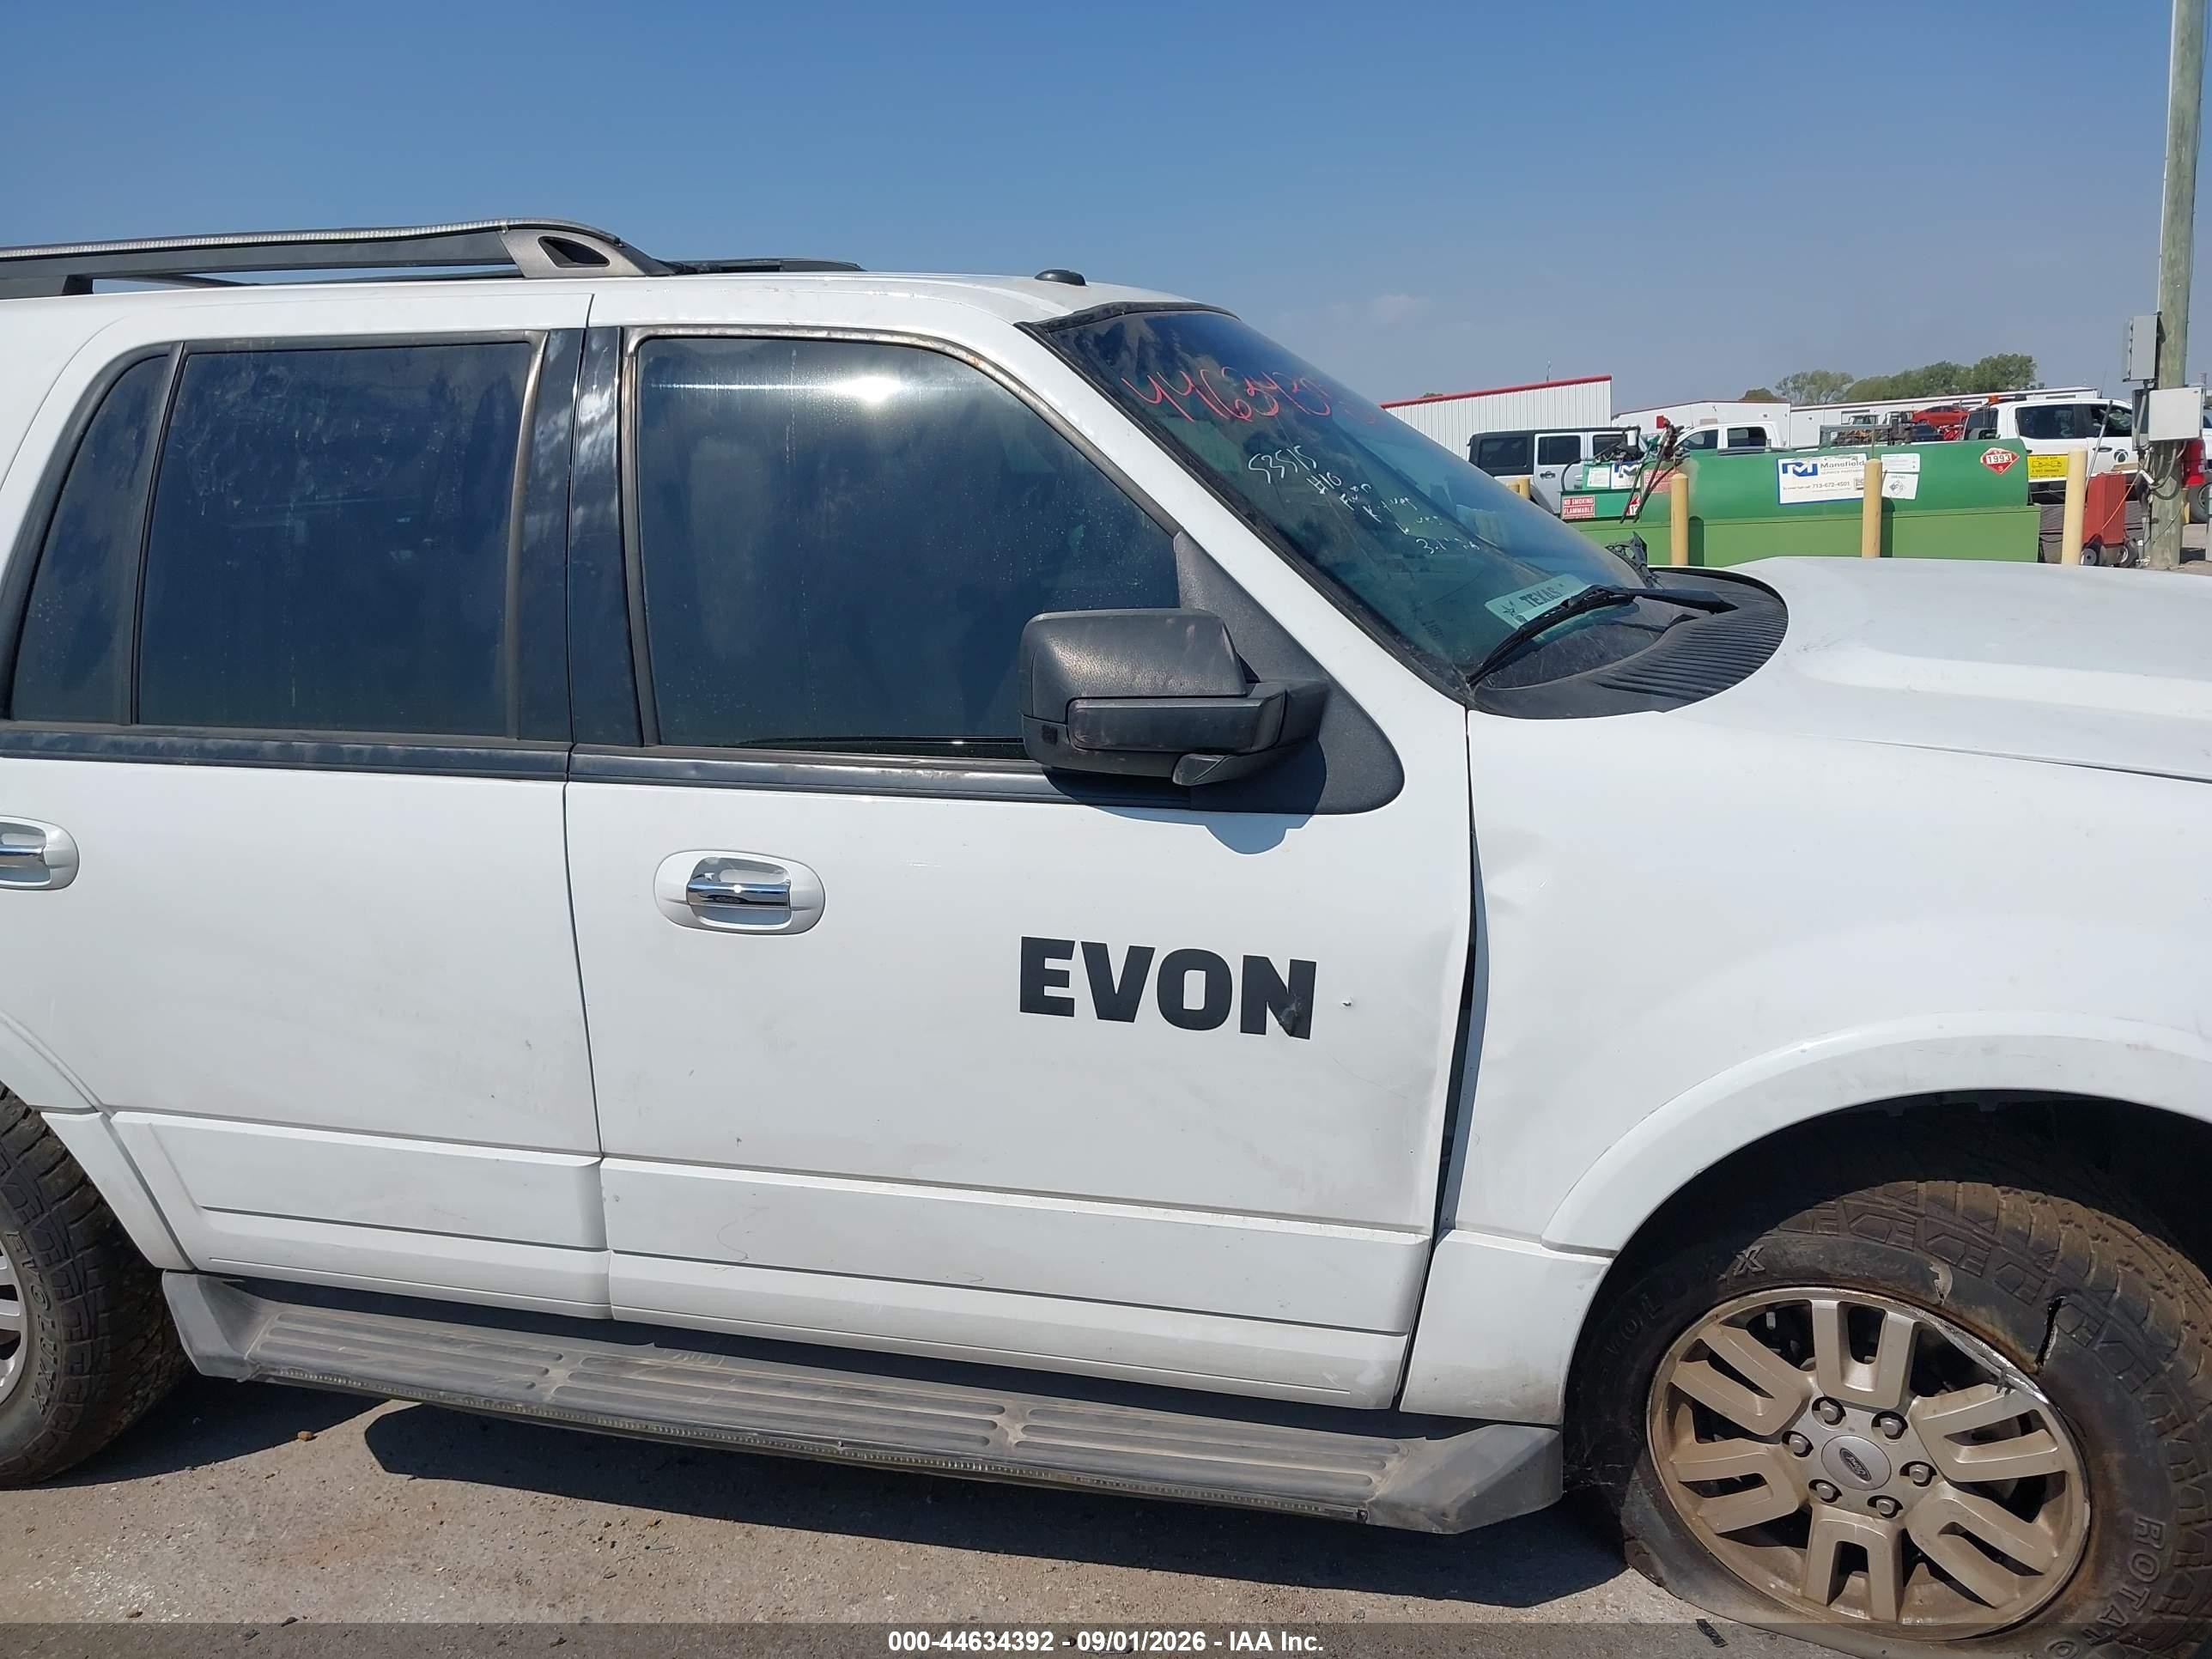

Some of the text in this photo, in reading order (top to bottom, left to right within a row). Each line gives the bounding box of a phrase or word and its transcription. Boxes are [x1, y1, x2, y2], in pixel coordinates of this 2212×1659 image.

[1987, 454, 2011, 464] 1993
[1820, 460, 1865, 469] Mansfield
[1564, 497, 1594, 506] NO SMOKING
[1564, 506, 1594, 515] FLAMMABLE
[1518, 586, 1563, 608] TEXAS
[1018, 935, 1317, 1041] EVON
